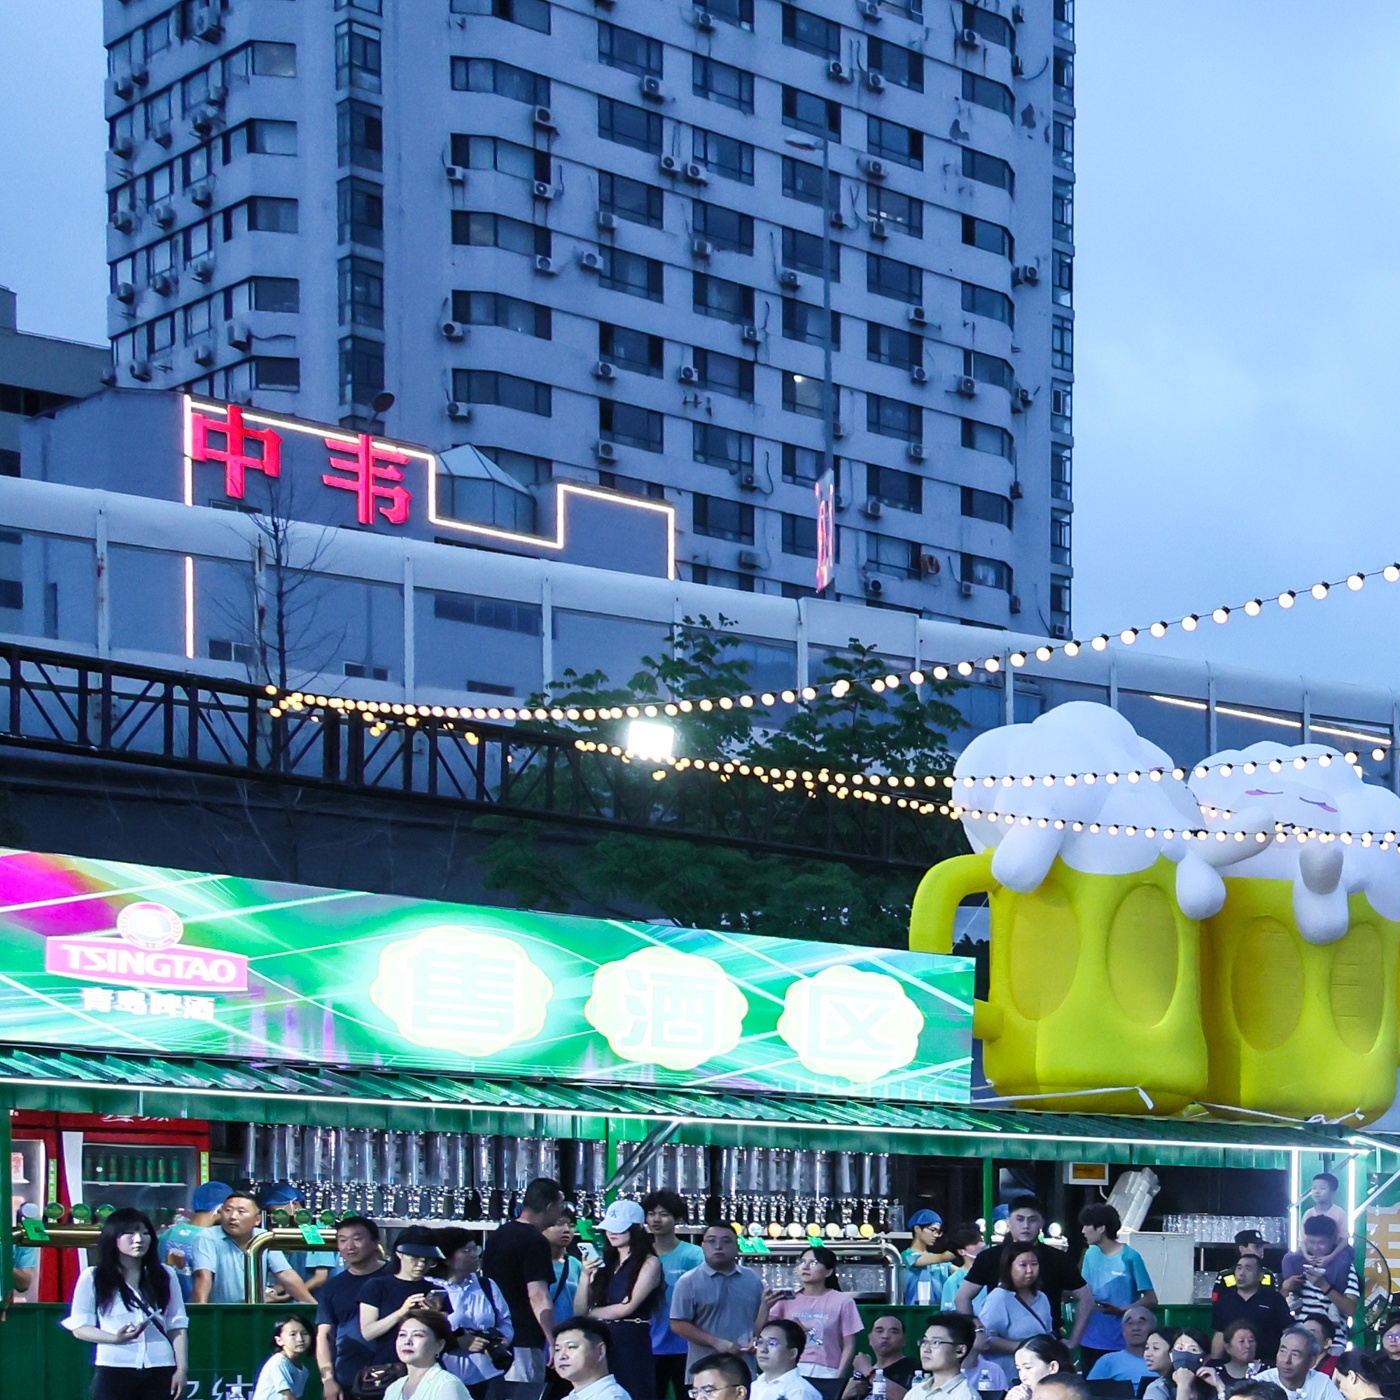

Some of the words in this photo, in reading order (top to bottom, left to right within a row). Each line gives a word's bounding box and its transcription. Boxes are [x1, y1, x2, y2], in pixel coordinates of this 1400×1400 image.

[60, 943, 237, 984] TSINGTAO
[81, 987, 215, 1021] 青岛啤酒
[406, 947, 898, 1065] 售酒区
